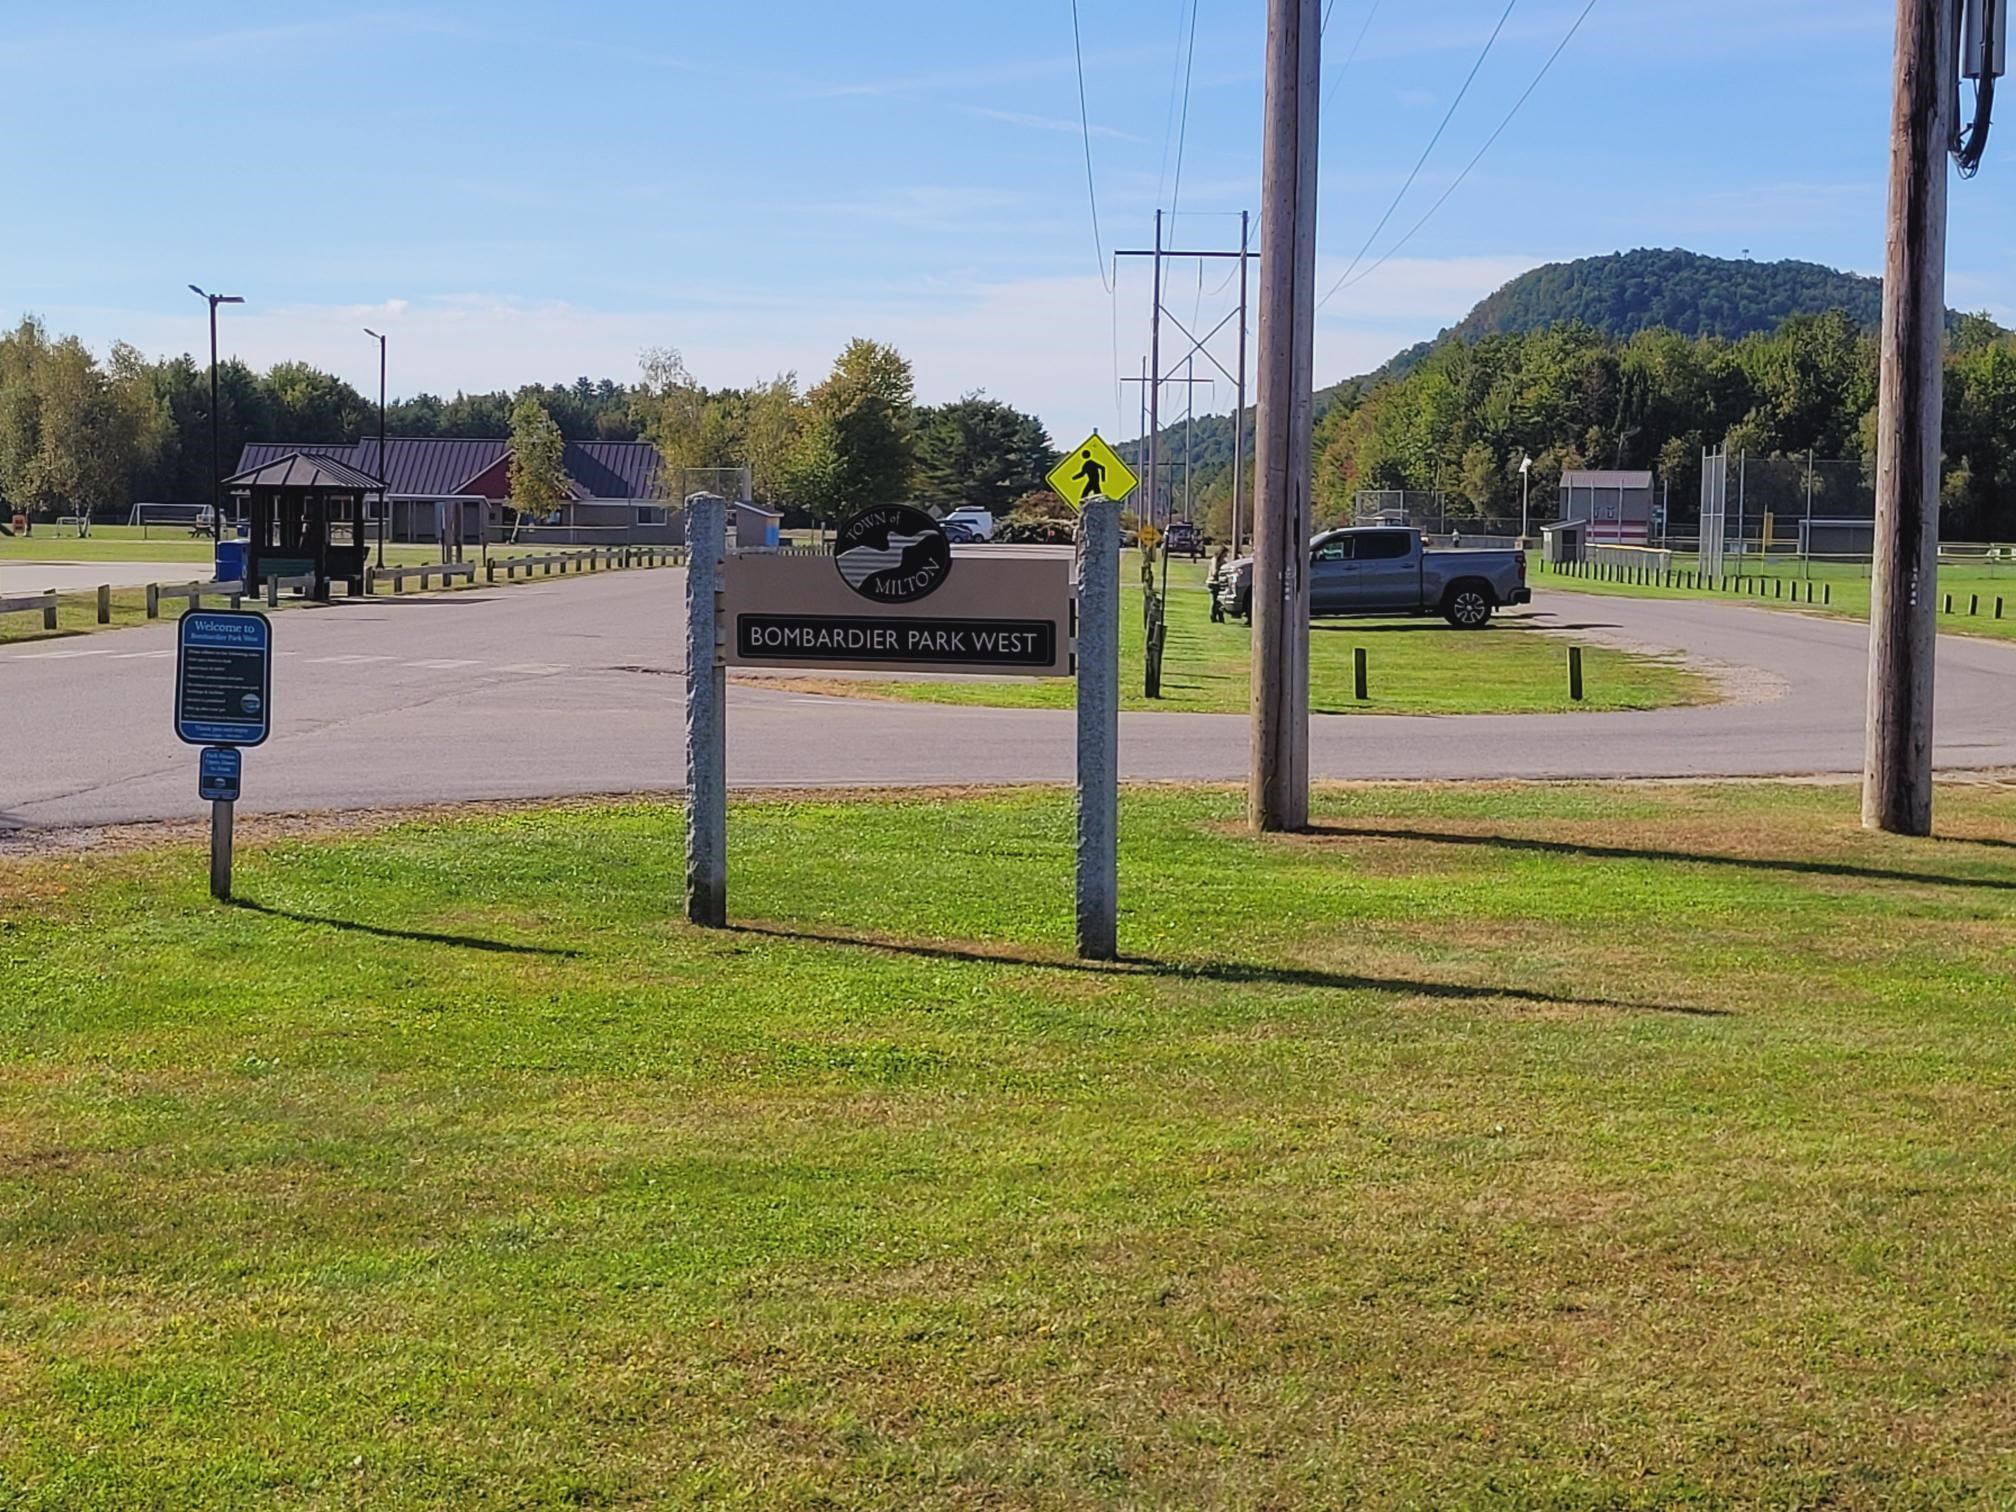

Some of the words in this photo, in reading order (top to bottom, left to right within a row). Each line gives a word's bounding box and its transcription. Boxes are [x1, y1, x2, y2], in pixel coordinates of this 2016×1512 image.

[845, 511, 887, 541] TOWN
[889, 511, 902, 525] of
[875, 557, 940, 595] MILTON
[194, 620, 242, 633] Welcome
[244, 624, 255, 634] to
[750, 626, 900, 650] BOMBARDIER
[908, 630, 966, 651] PARK
[971, 631, 1038, 653] WEST
